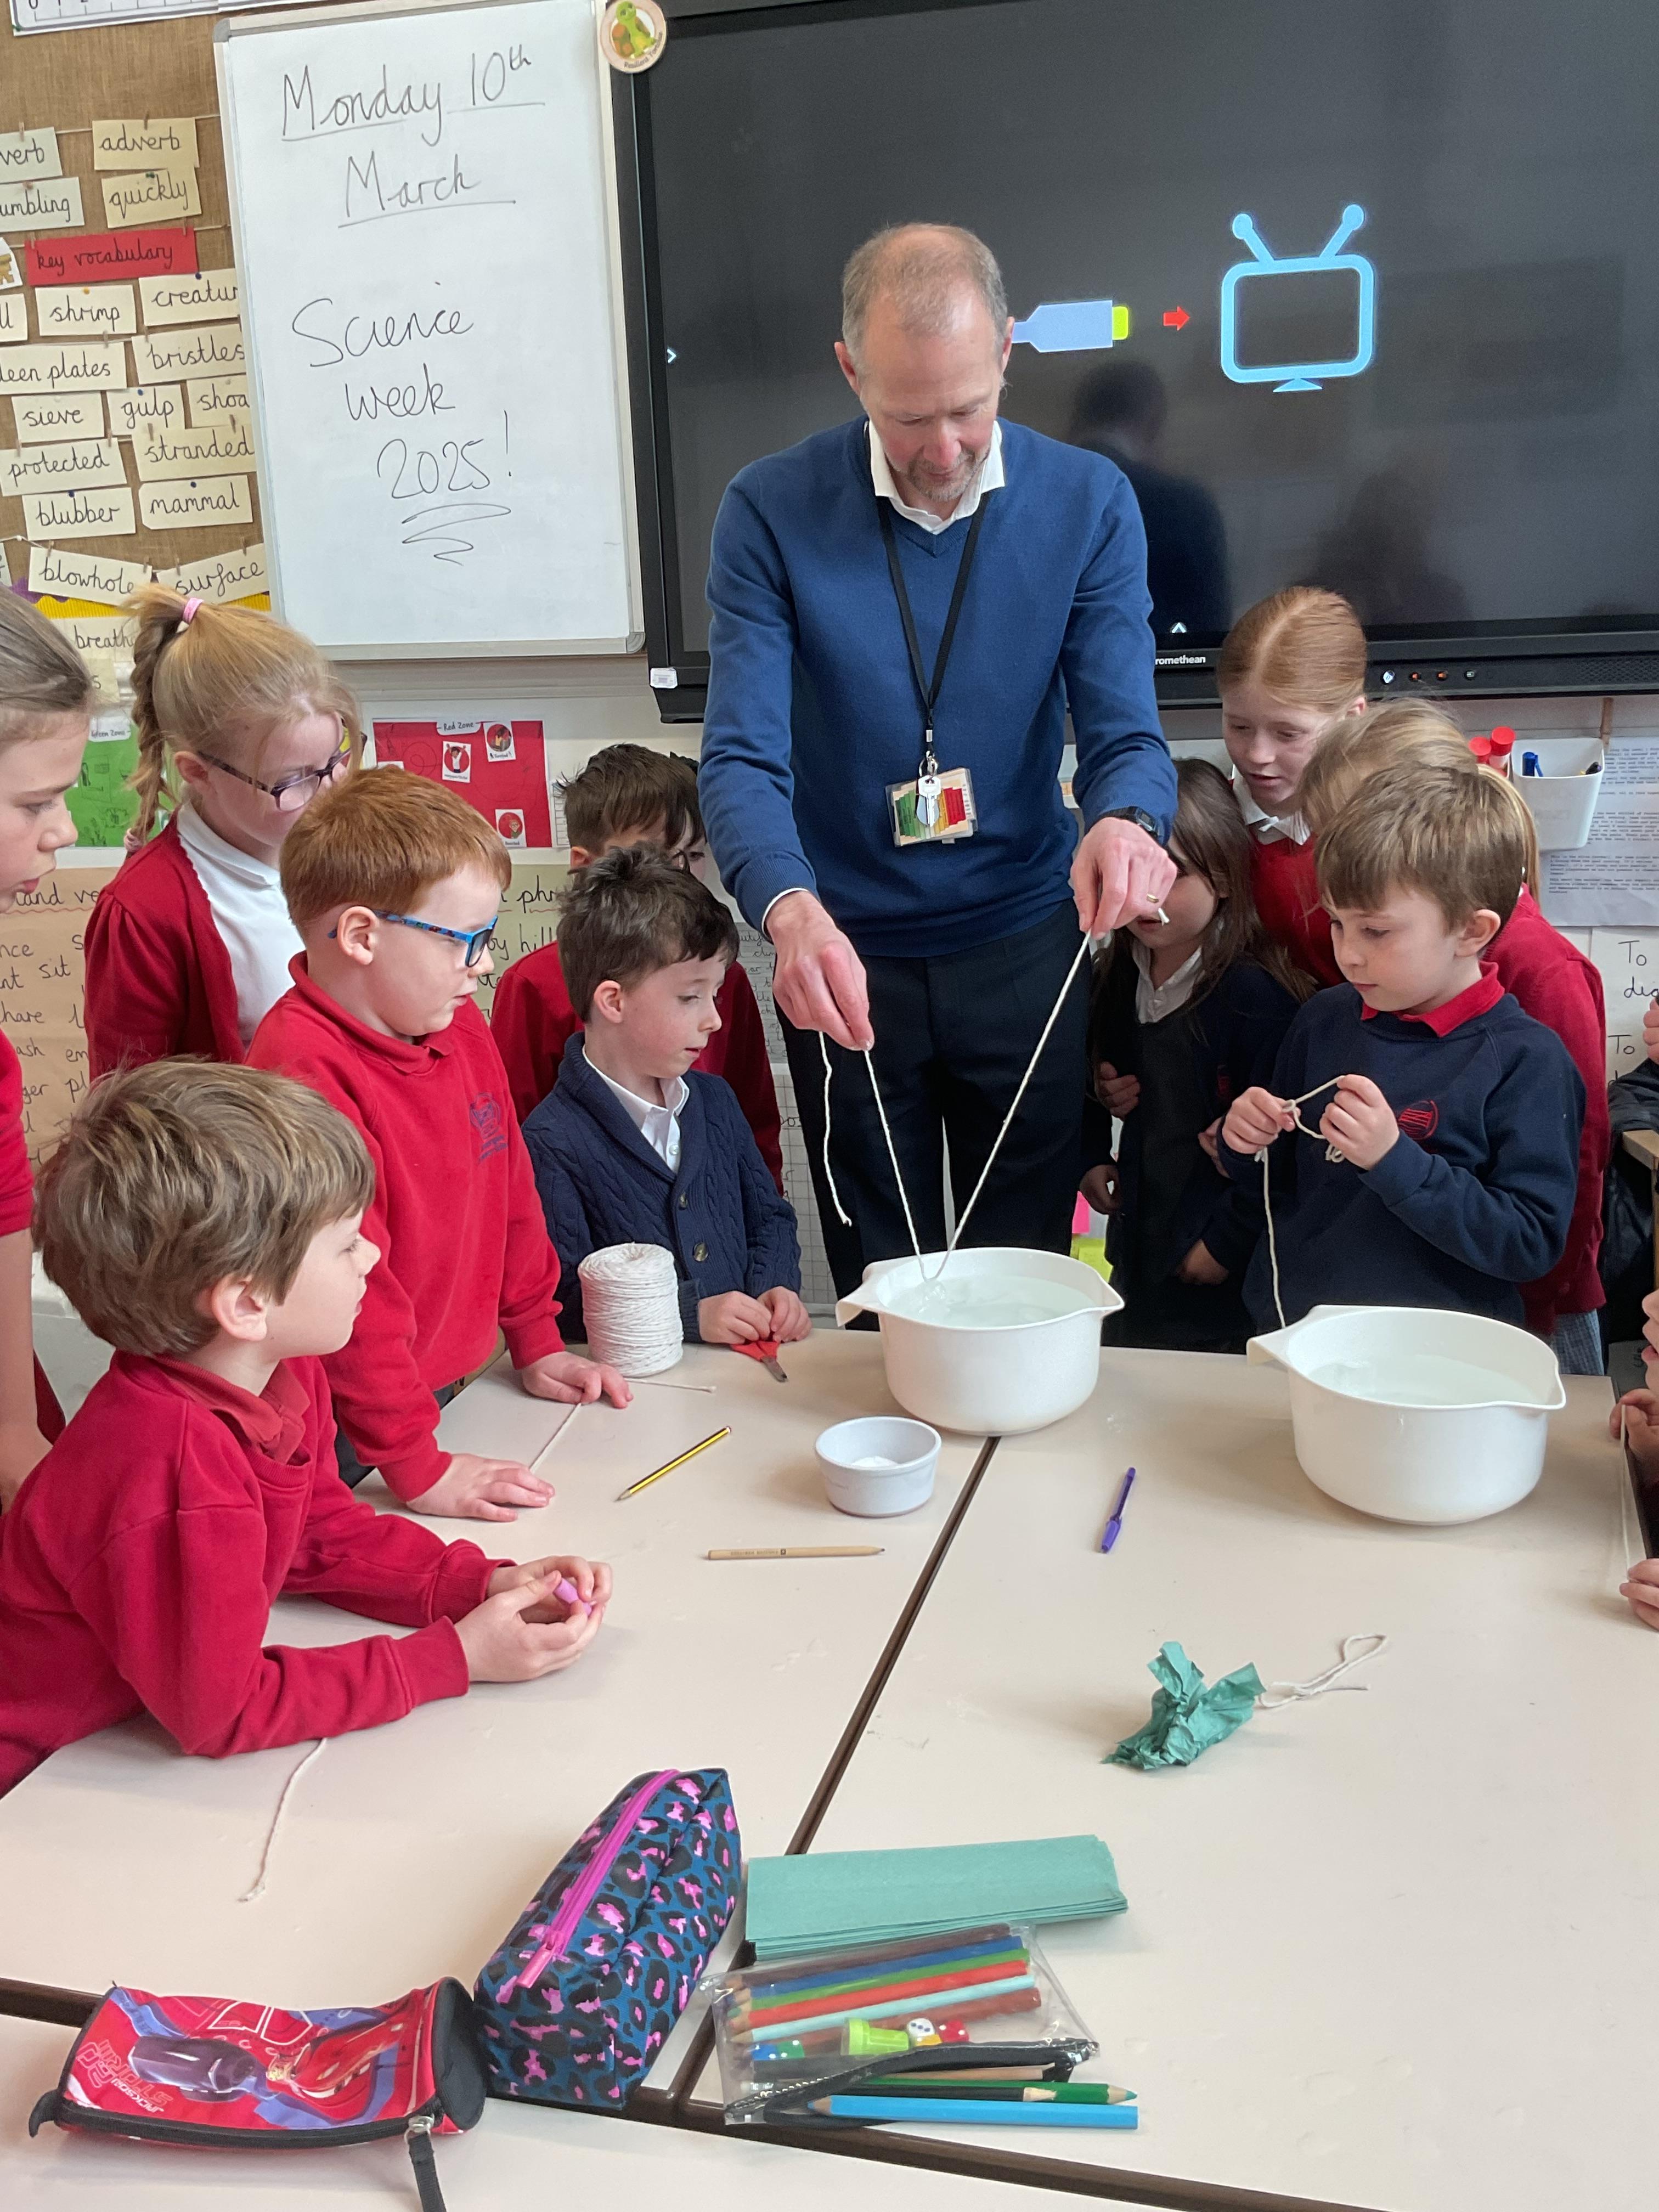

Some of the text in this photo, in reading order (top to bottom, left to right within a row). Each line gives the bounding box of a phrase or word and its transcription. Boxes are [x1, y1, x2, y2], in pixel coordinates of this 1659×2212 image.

[281, 65, 442, 146] Monday
[99, 124, 182, 151] adverb
[109, 171, 189, 219] quickly
[346, 151, 478, 217] March
[0, 189, 71, 223] umbling
[37, 238, 173, 276] key vocabulary
[151, 279, 238, 307] creatur
[49, 295, 120, 332] shrimp
[292, 281, 475, 367] Science
[146, 334, 245, 370] bristles
[0, 351, 111, 389] leen plates
[121, 387, 174, 429] gulp
[196, 383, 250, 411] shoa
[23, 406, 84, 427] sieve
[144, 425, 255, 462] stranded
[8, 447, 109, 485] protected
[36, 496, 121, 527] blubber
[149, 483, 240, 515] mammal
[39, 557, 134, 595] blowhole
[175, 562, 264, 596] surface
[74, 624, 134, 649] breath
[1155, 654, 1206, 665] romethean
[16, 881, 65, 906] and
[0, 944, 34, 958] nce
[1618, 940, 1647, 966] To
[0, 954, 71, 990] nt sit
[0, 1000, 45, 1024] hare
[16, 1037, 46, 1057] ash
[1607, 1034, 1635, 1054] To
[22, 1084, 49, 1105] ger
[111, 2078, 165, 2113] JACKSON
